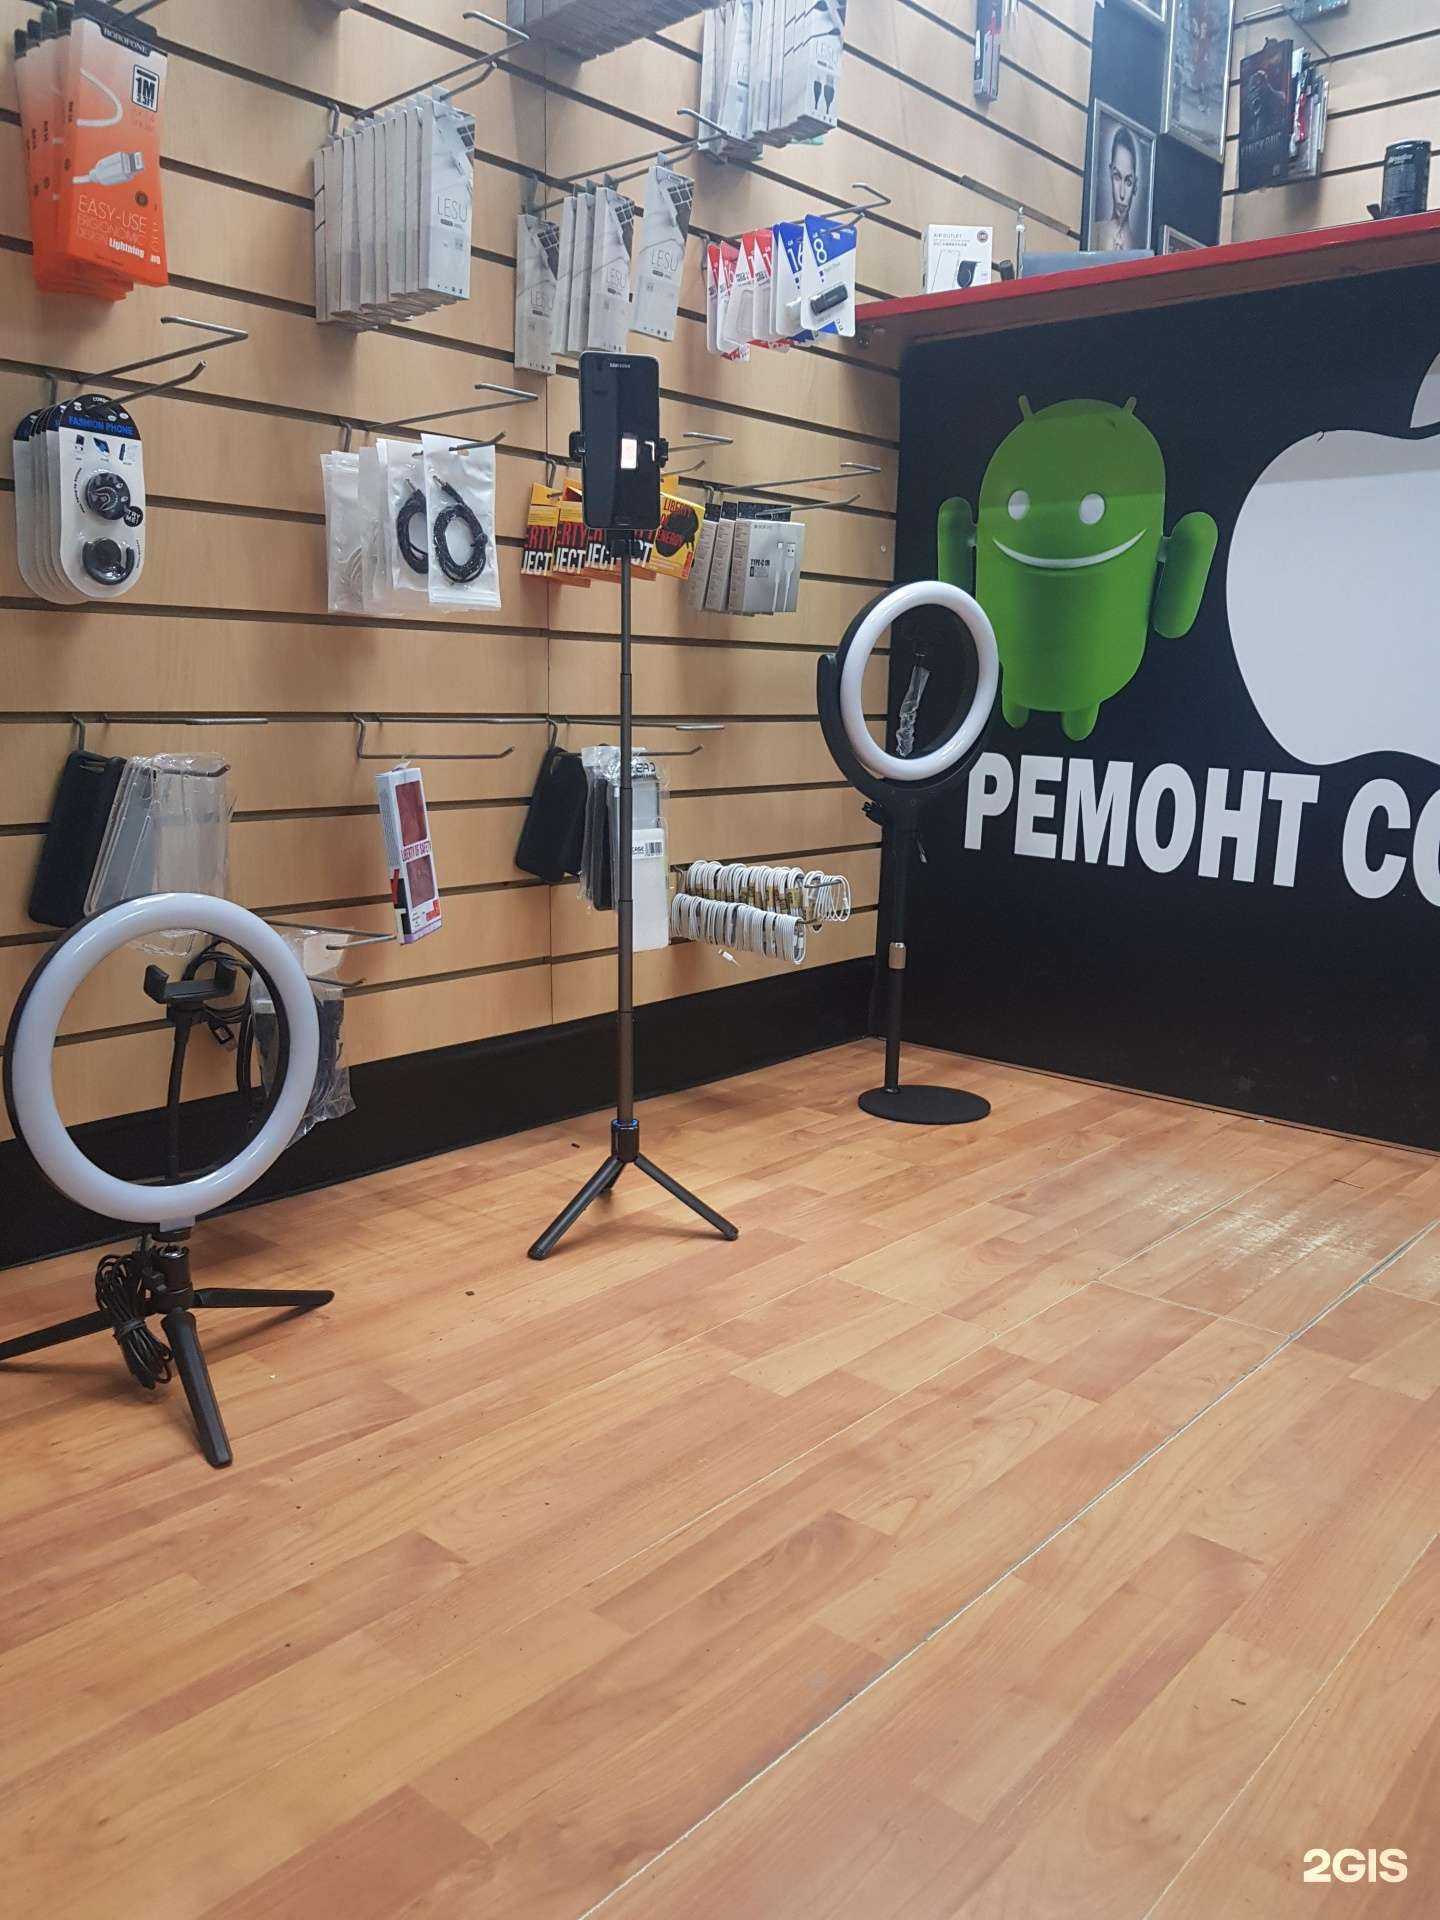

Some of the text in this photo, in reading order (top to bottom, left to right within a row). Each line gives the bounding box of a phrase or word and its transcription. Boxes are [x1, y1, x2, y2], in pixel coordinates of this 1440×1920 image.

[135, 77, 155, 101] 1M
[79, 194, 147, 234] EASY-USE
[108, 237, 145, 259] Lightning
[813, 238, 828, 264] 8
[69, 416, 135, 436] FASHION PHONE
[964, 751, 1321, 887] РЕМОНТ
